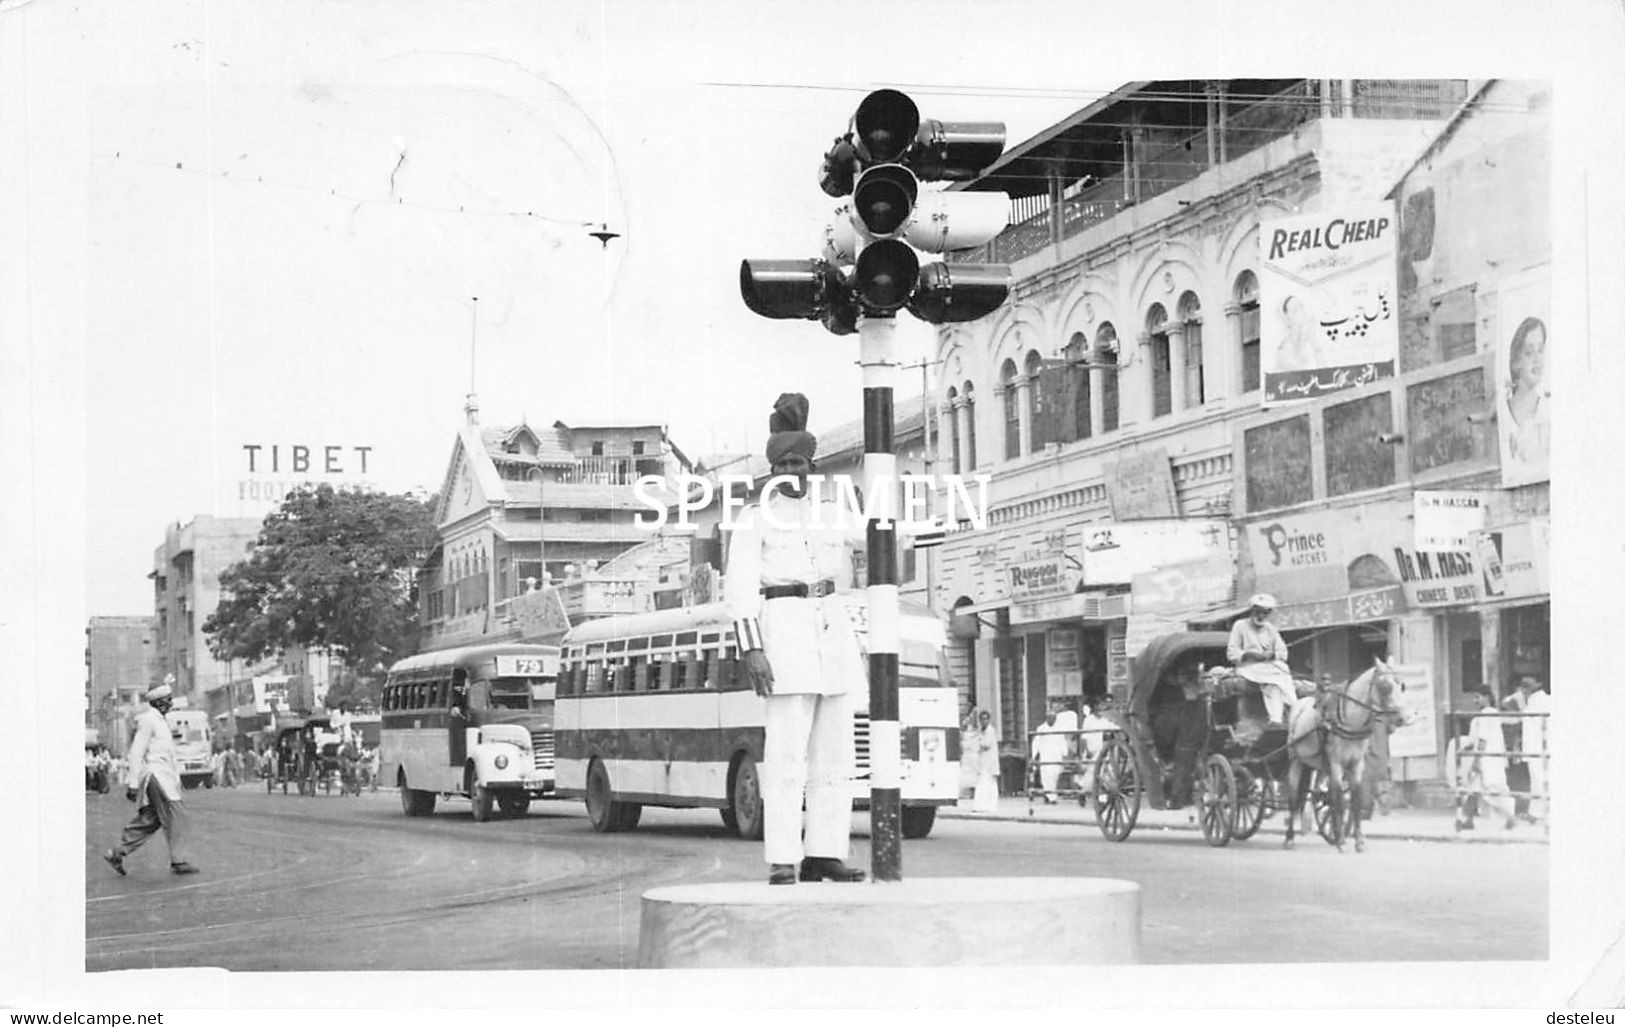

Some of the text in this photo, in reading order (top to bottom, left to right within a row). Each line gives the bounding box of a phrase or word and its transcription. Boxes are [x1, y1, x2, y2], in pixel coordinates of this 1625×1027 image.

[1268, 217, 1390, 260] REAL CHEAP
[242, 444, 373, 474] TIBET
[1259, 522, 1326, 567] Prince
[1415, 587, 1448, 603] CHINESE
[517, 658, 544, 674] 79
